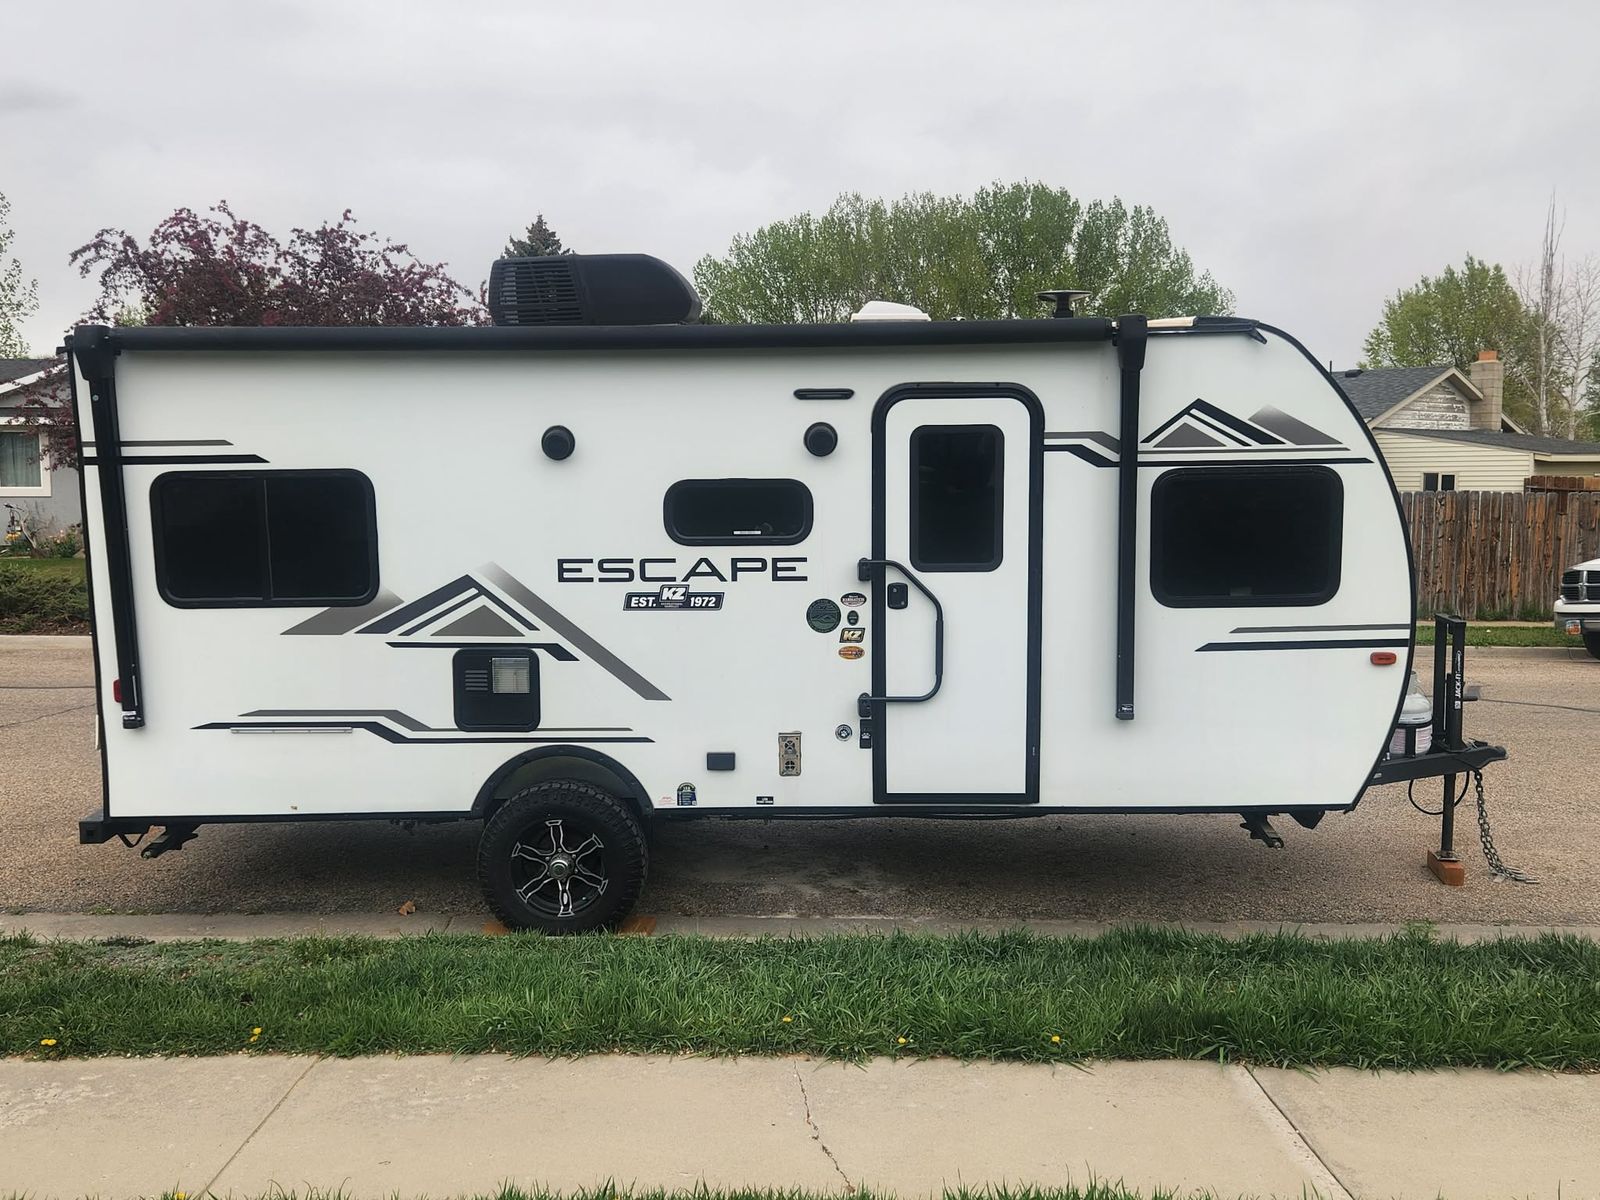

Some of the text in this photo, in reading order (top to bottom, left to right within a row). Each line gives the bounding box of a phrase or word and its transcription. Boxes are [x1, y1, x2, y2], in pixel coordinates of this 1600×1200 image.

[557, 558, 807, 582] ESCAPE
[662, 587, 686, 600] KZ
[630, 597, 656, 607] EST.
[690, 597, 716, 607] 1972
[843, 630, 862, 641] KZ
